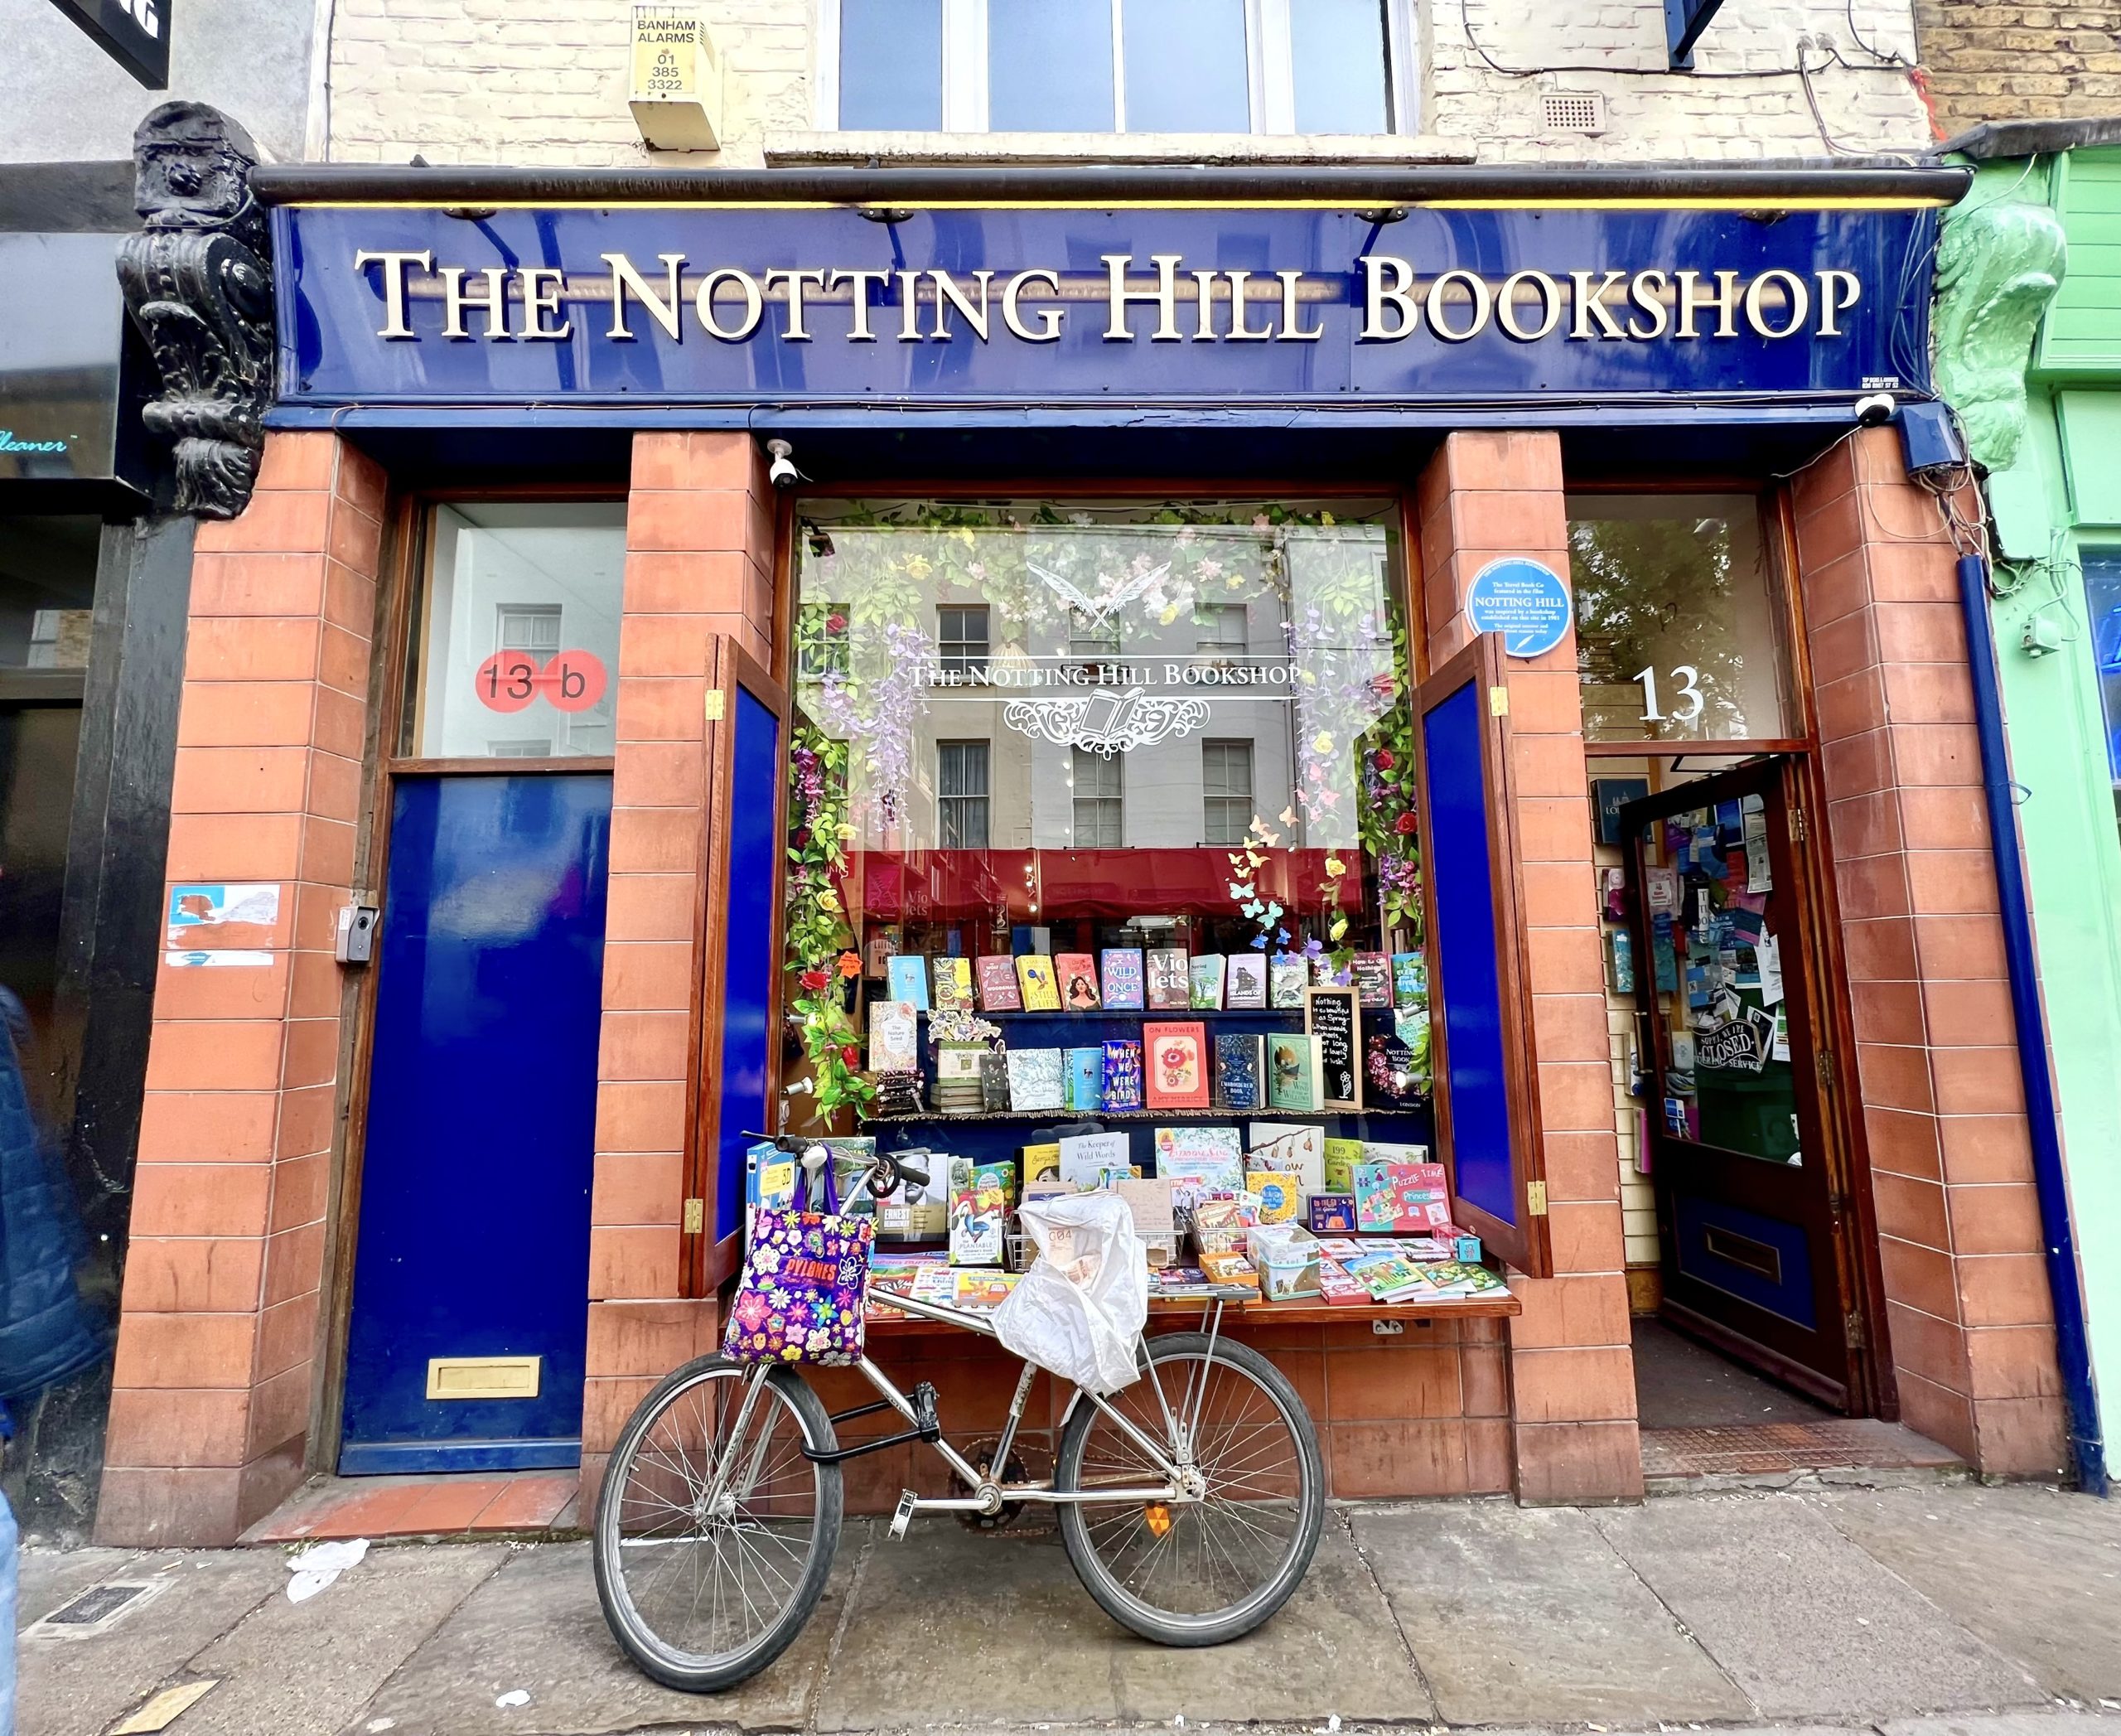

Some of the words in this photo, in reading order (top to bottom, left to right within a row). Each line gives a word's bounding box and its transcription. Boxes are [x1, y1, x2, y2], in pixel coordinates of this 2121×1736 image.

[637, 20, 696, 31] BANHAM
[638, 32, 694, 43] ALARMS
[657, 54, 674, 65] 01
[652, 66, 679, 77] 385
[647, 79, 683, 90] 3322
[354, 249, 570, 339] THE
[602, 253, 1069, 343] NOTTING
[1099, 253, 1326, 343] HILL
[1363, 254, 1863, 341] BOOKSHOP
[1475, 597, 1532, 607] NOTTING
[1535, 597, 1564, 607] HILL
[484, 664, 533, 699] 13
[562, 663, 585, 699] b
[908, 665, 961, 687] THE
[969, 665, 1090, 687] NOTTING
[1097, 665, 1158, 685] HILL
[1163, 664, 1302, 686] BOOKSHOP
[1632, 665, 1703, 720] 13
[1152, 954, 1187, 971] Vio
[1108, 967, 1137, 976] WILD
[1150, 971, 1188, 989] lets
[1108, 983, 1138, 992] ONCE
[1316, 997, 1342, 1009] Nothing
[1332, 1040, 1348, 1052] long
[1701, 1033, 1751, 1064] CLOSED
[1114, 1049, 1135, 1059] WHEN
[1118, 1062, 1129, 1072] WE
[1113, 1076, 1134, 1086] WERE
[1111, 1090, 1136, 1100] BIRDS
[1088, 1140, 1109, 1149] Keeper
[1332, 1146, 1346, 1154] 199
[885, 1208, 911, 1220] ERNEST
[785, 1258, 837, 1281] PYLONES
